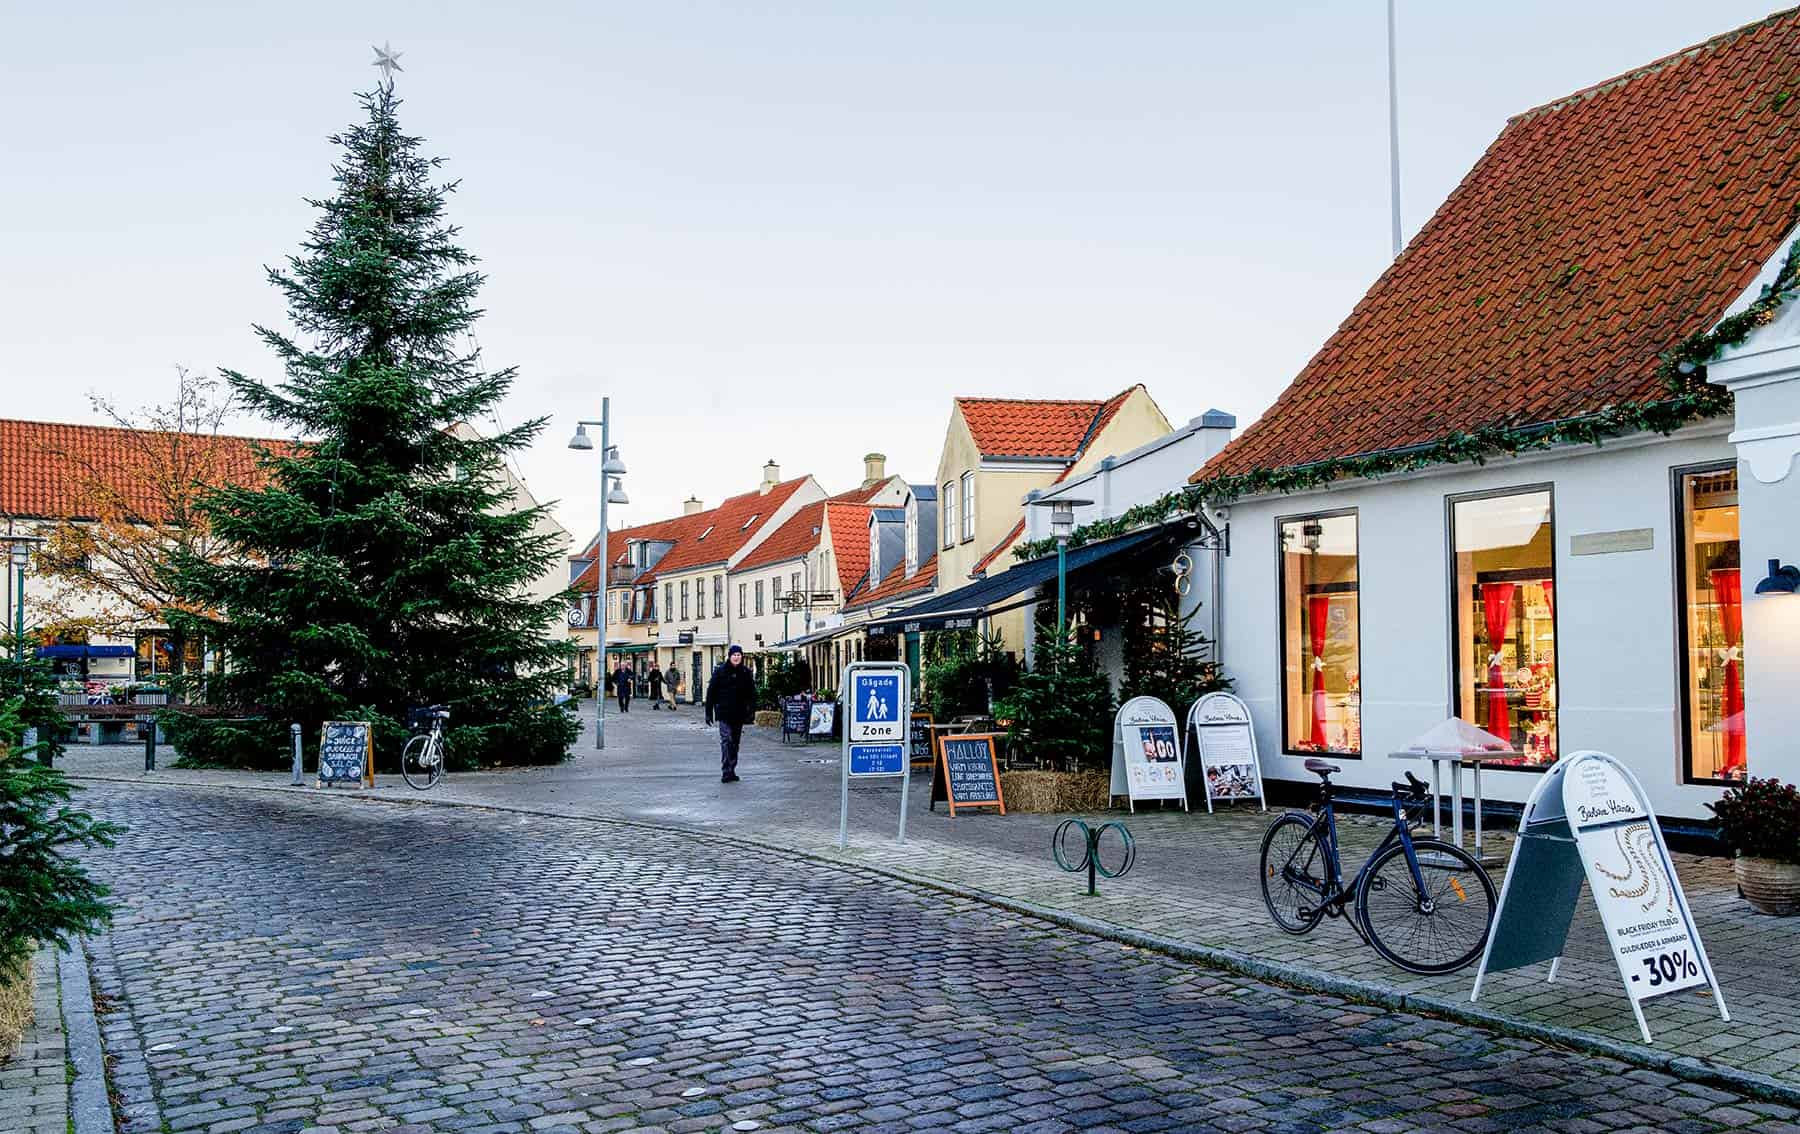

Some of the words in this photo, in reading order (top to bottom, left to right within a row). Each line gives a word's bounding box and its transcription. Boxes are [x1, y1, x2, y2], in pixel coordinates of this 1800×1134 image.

[862, 678, 893, 688] Gågade
[862, 726, 892, 735] Zone
[1617, 926, 1638, 936] BLACK
[1637, 922, 1659, 932] FRIDAY
[1643, 949, 1698, 986] 30%
